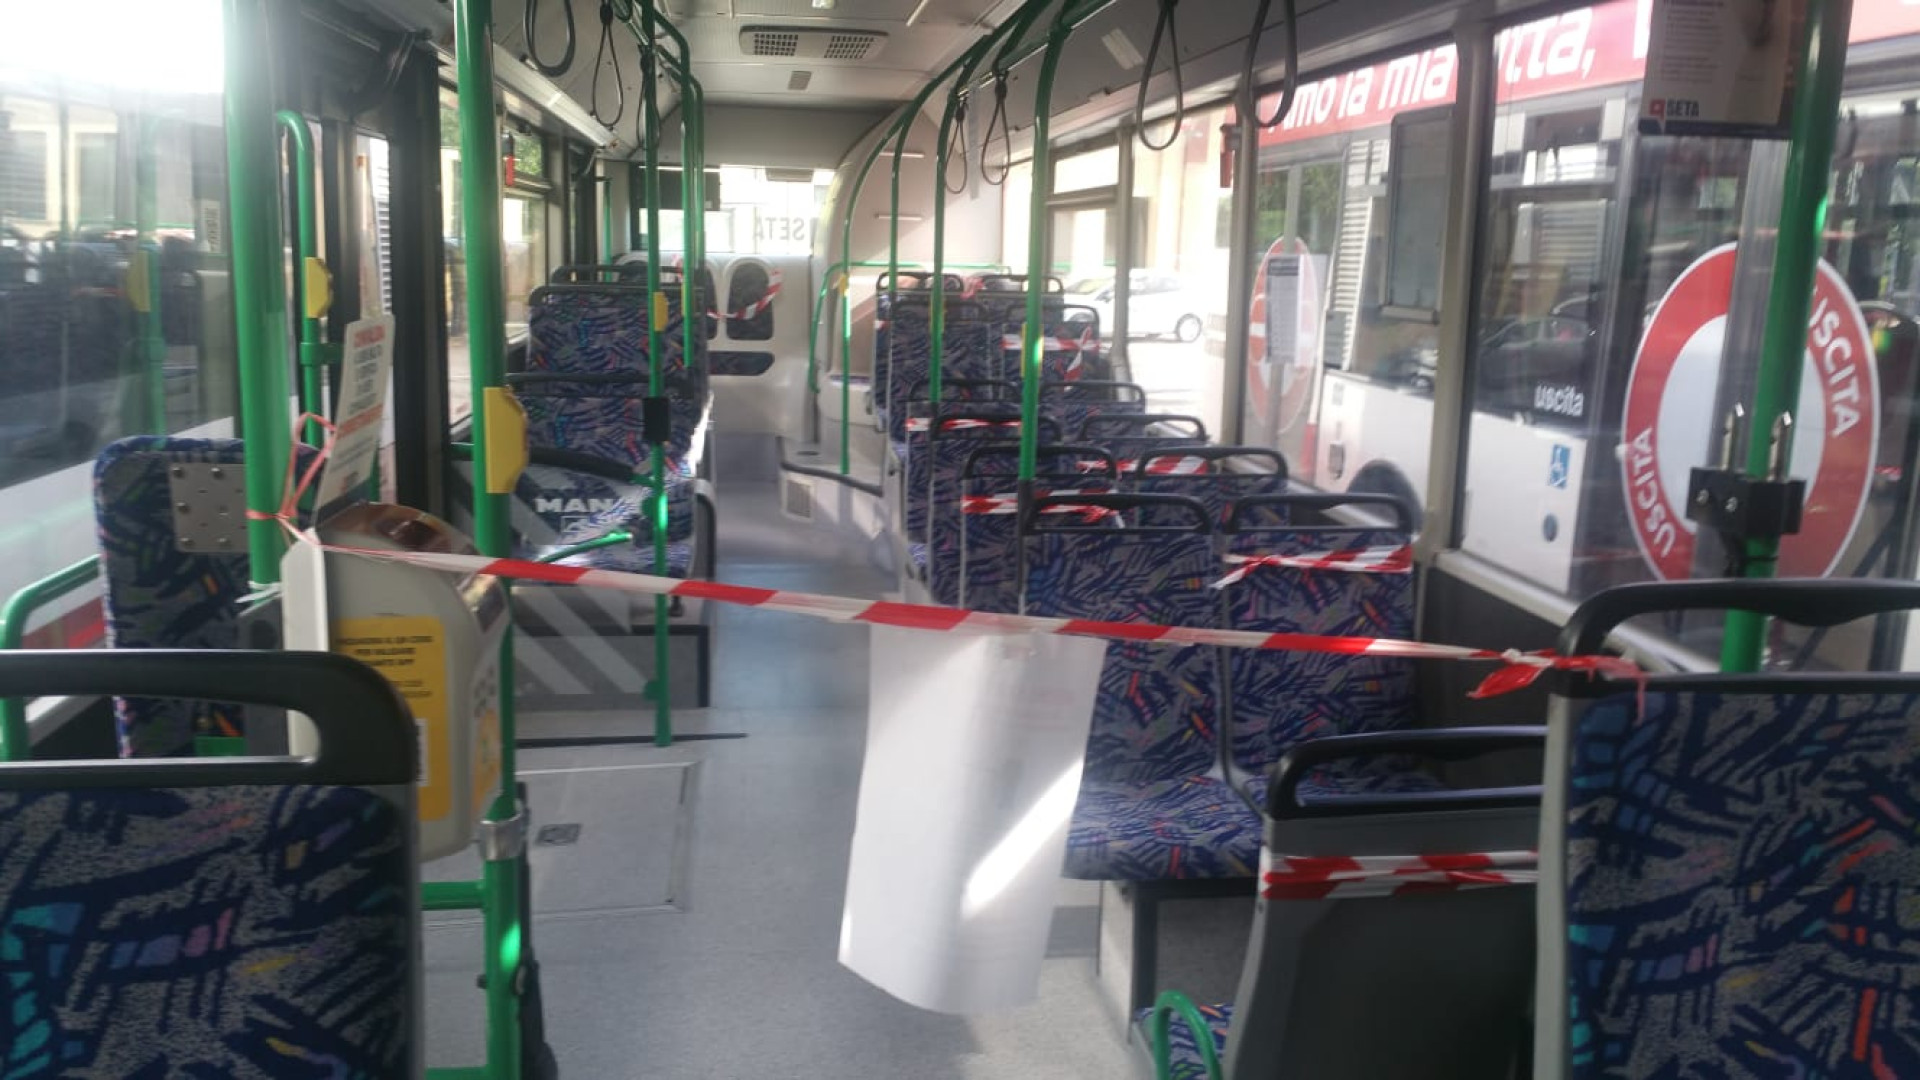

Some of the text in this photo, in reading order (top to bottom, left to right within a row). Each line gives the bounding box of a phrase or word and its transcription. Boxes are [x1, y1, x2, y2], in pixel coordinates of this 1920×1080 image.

[1378, 44, 1457, 111] mia
[1666, 99, 1699, 117] SETA
[1533, 385, 1584, 417] uscita
[534, 498, 614, 513] MAN
[1631, 427, 1677, 558] USCITA
